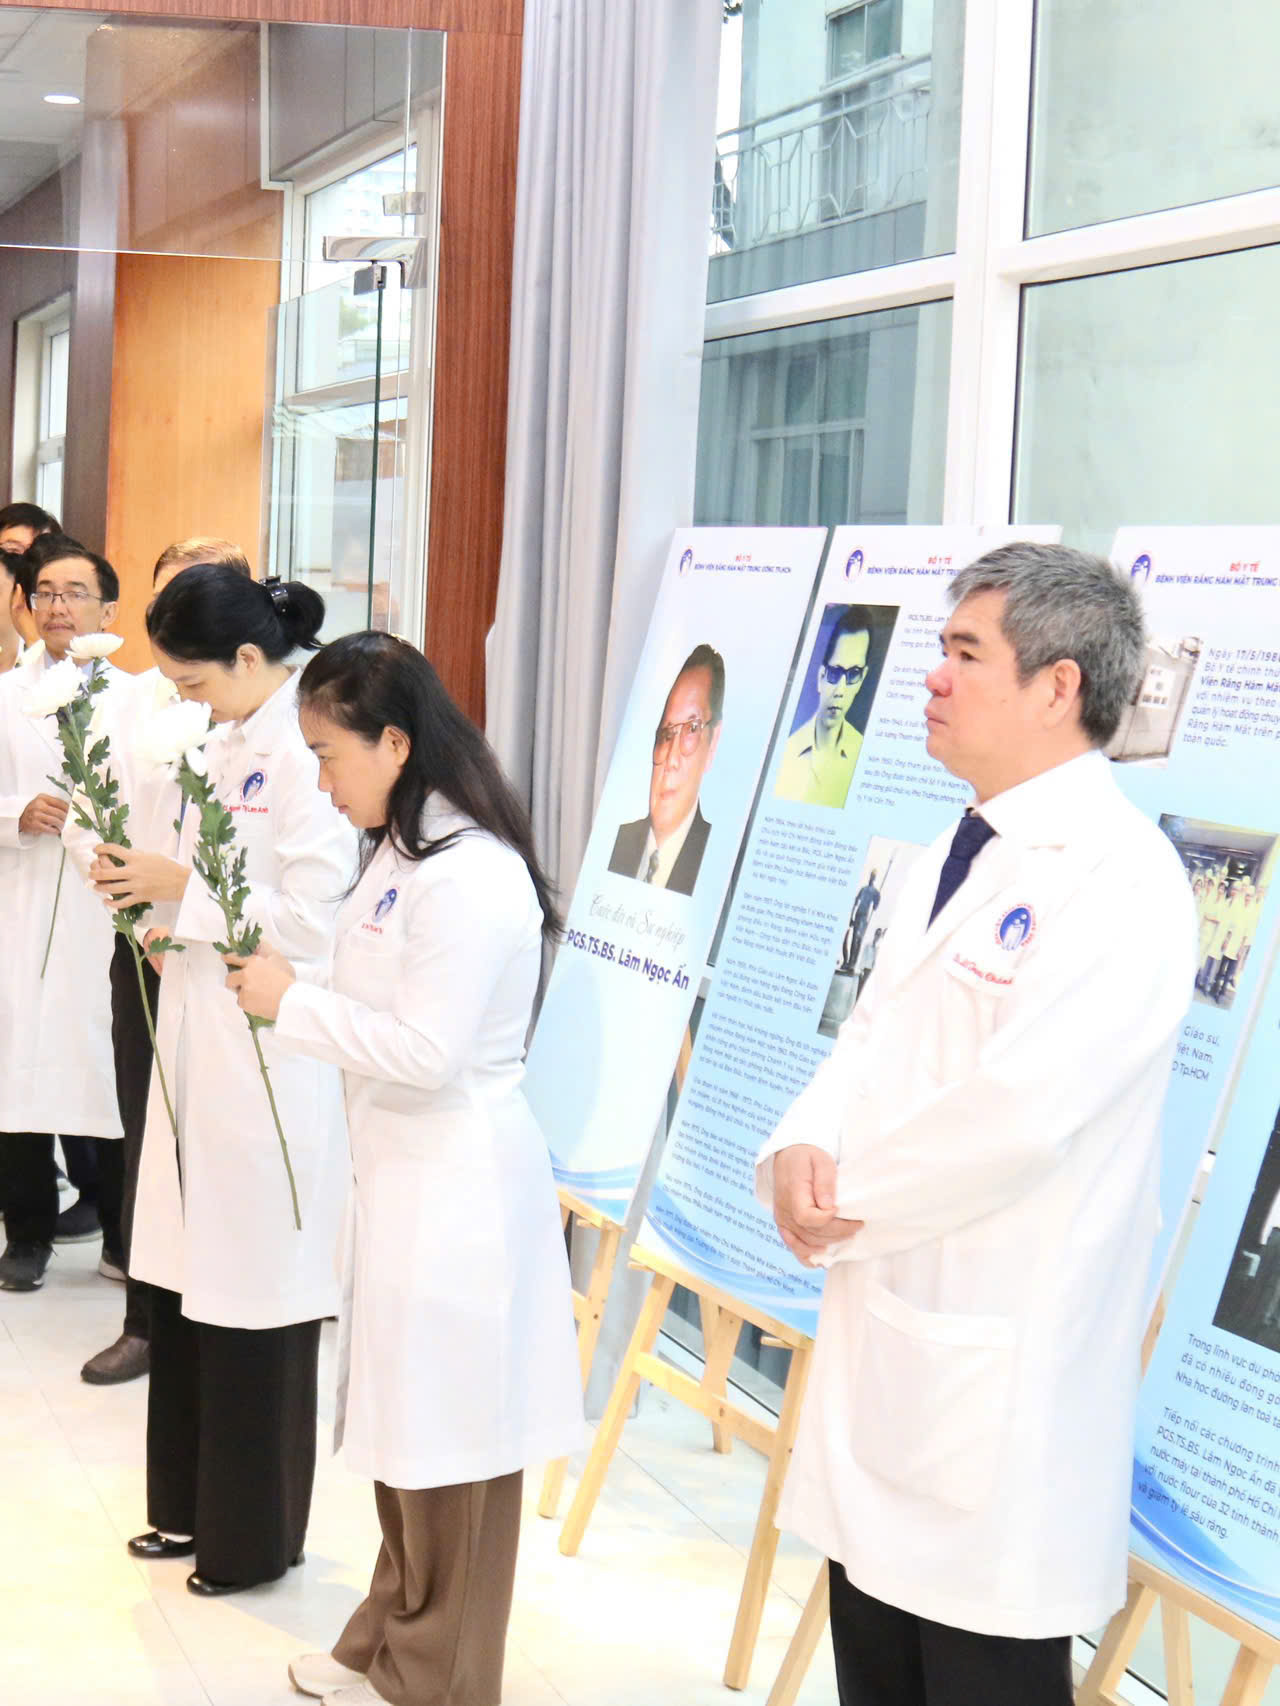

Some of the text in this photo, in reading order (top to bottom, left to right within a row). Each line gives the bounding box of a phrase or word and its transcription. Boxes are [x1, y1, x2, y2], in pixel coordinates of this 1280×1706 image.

[567, 929, 615, 961] PGS.TS.BS.
[618, 948, 640, 971] Lâm
[642, 958, 671, 984] Ngọc
[672, 964, 689, 990] Ấn
[1156, 1425, 1276, 1494] PGS.TS.BS. Lâm Ngọc Ấn đã
[1200, 1428, 1216, 1442] các
[1217, 1436, 1254, 1462] chương
[1144, 1464, 1279, 1542] với nước flour của 32 tỉnh thành
[1150, 1446, 1276, 1517] nước máy tại thành phố Hồ Chí
